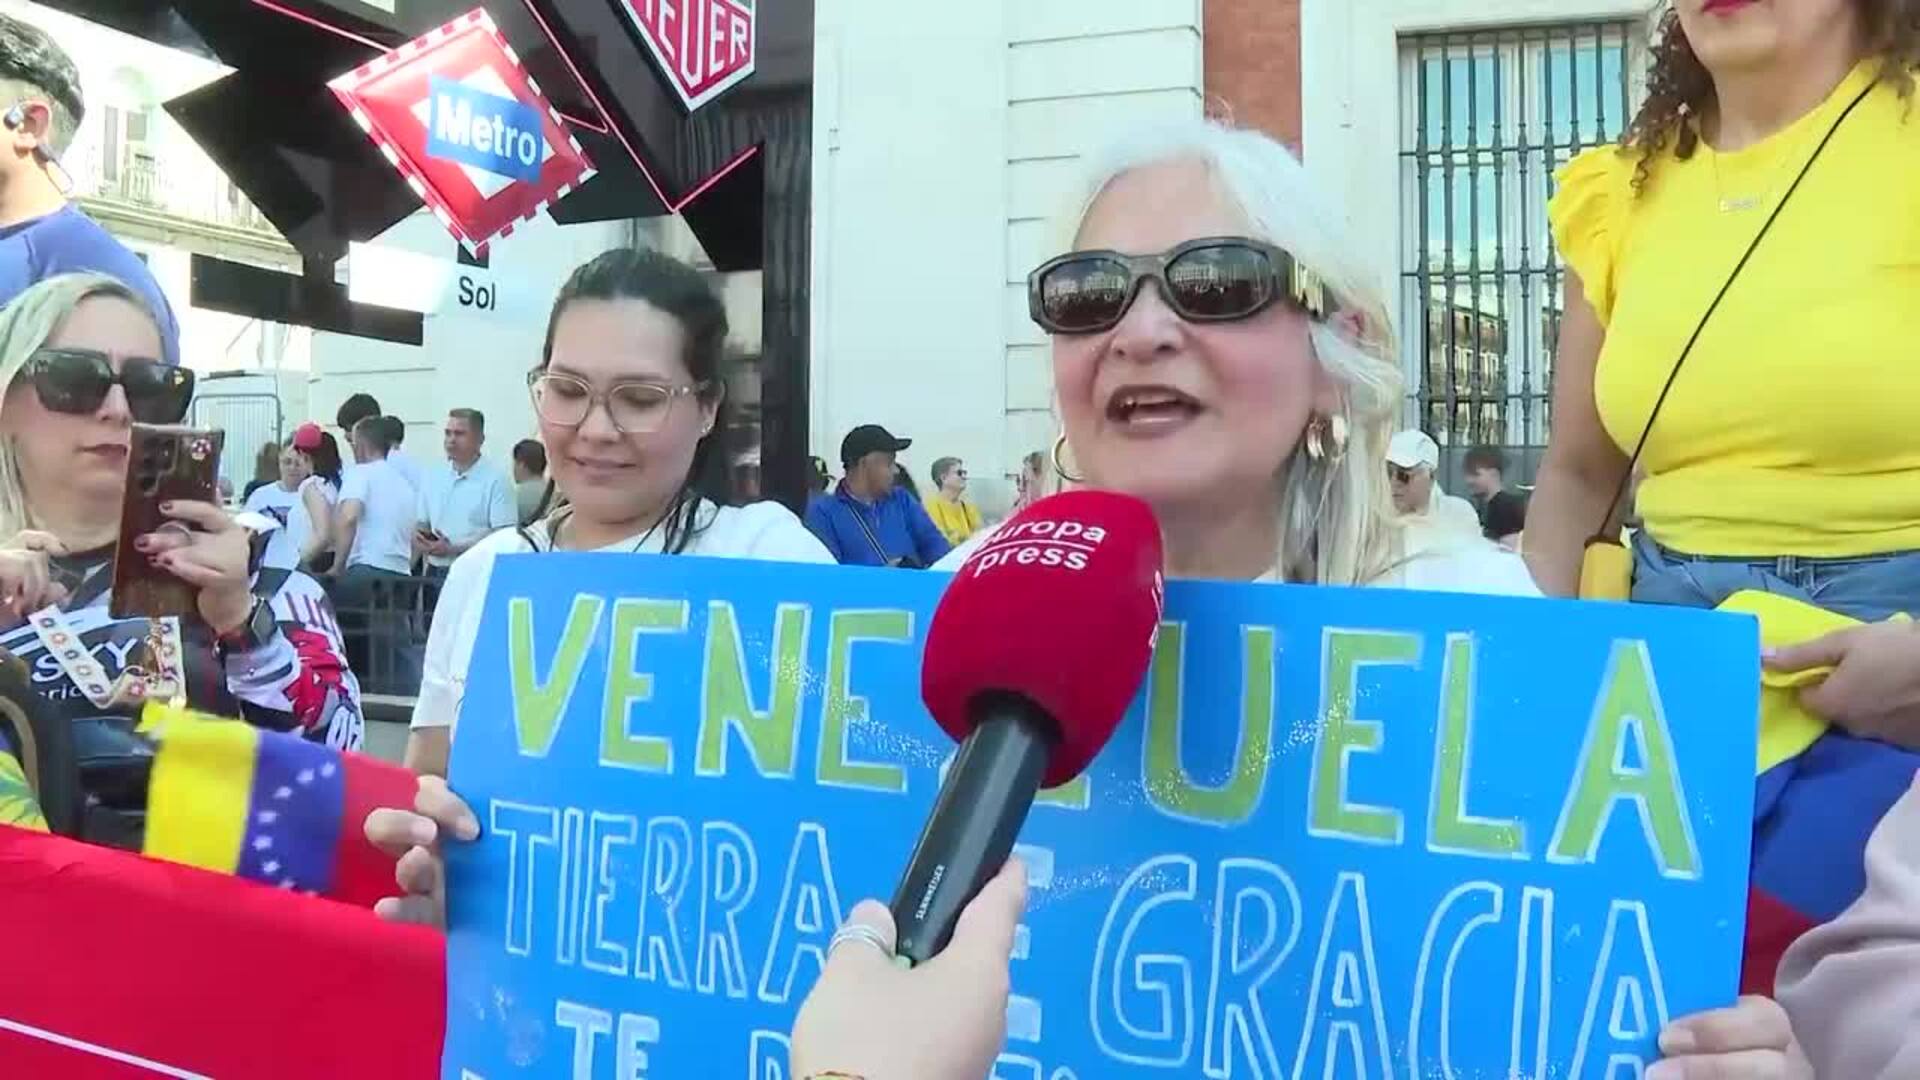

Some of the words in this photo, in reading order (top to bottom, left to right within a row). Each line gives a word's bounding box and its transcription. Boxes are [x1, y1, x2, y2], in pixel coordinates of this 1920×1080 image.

[436, 93, 537, 166] Metro
[458, 275, 496, 311] Sol
[972, 546, 1089, 578] press
[508, 592, 1702, 881] VENEUELA
[490, 798, 845, 1004] TIERRA
[1089, 854, 1671, 1080] GRACIA
